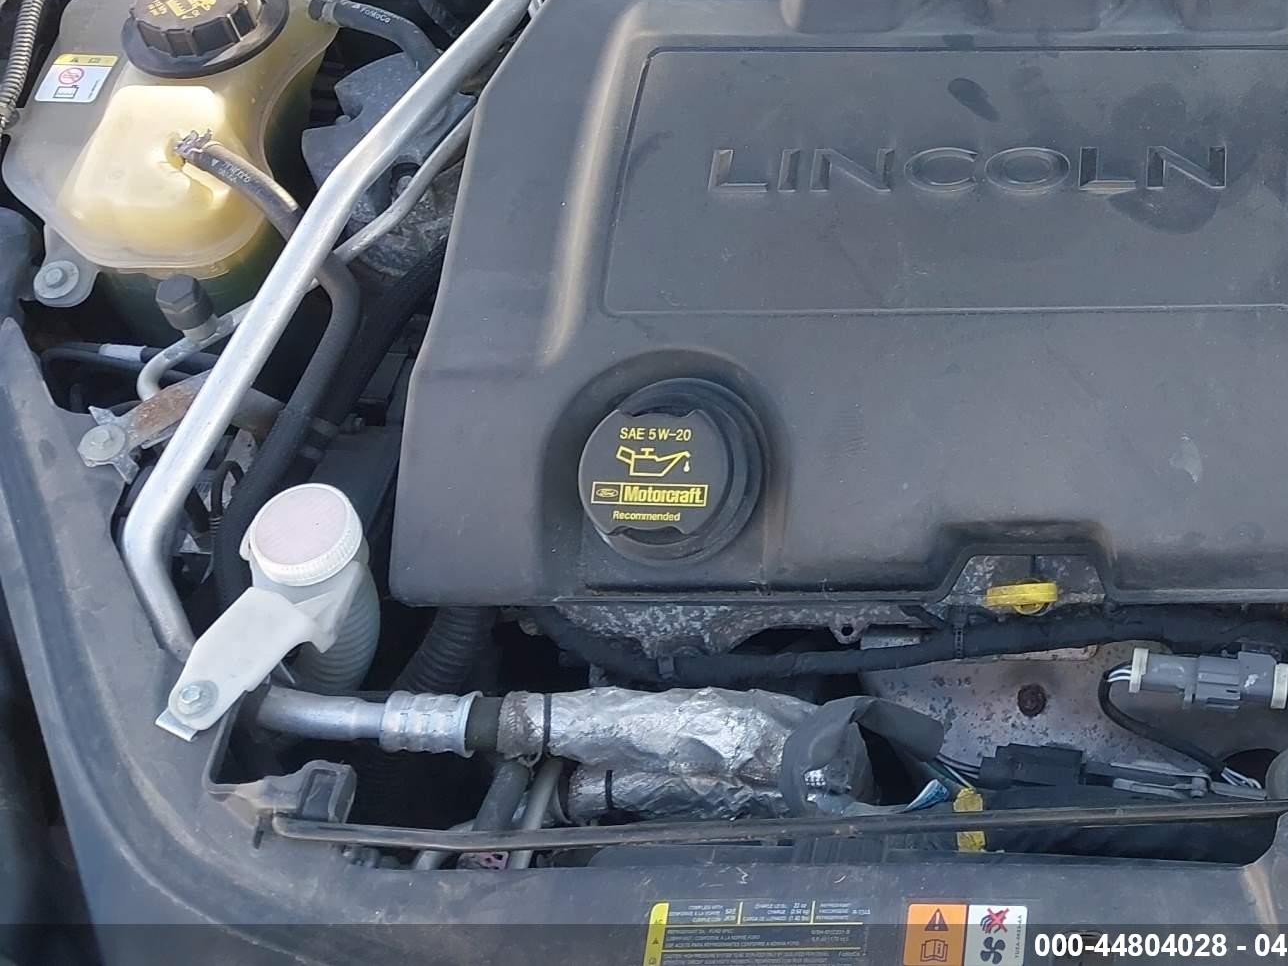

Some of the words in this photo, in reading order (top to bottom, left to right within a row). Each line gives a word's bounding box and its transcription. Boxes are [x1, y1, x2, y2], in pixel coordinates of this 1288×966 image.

[707, 145, 1229, 196] LINCOLN
[619, 427, 646, 440] SAE
[648, 428, 692, 441] 5W-20
[612, 510, 681, 522] Recommended
